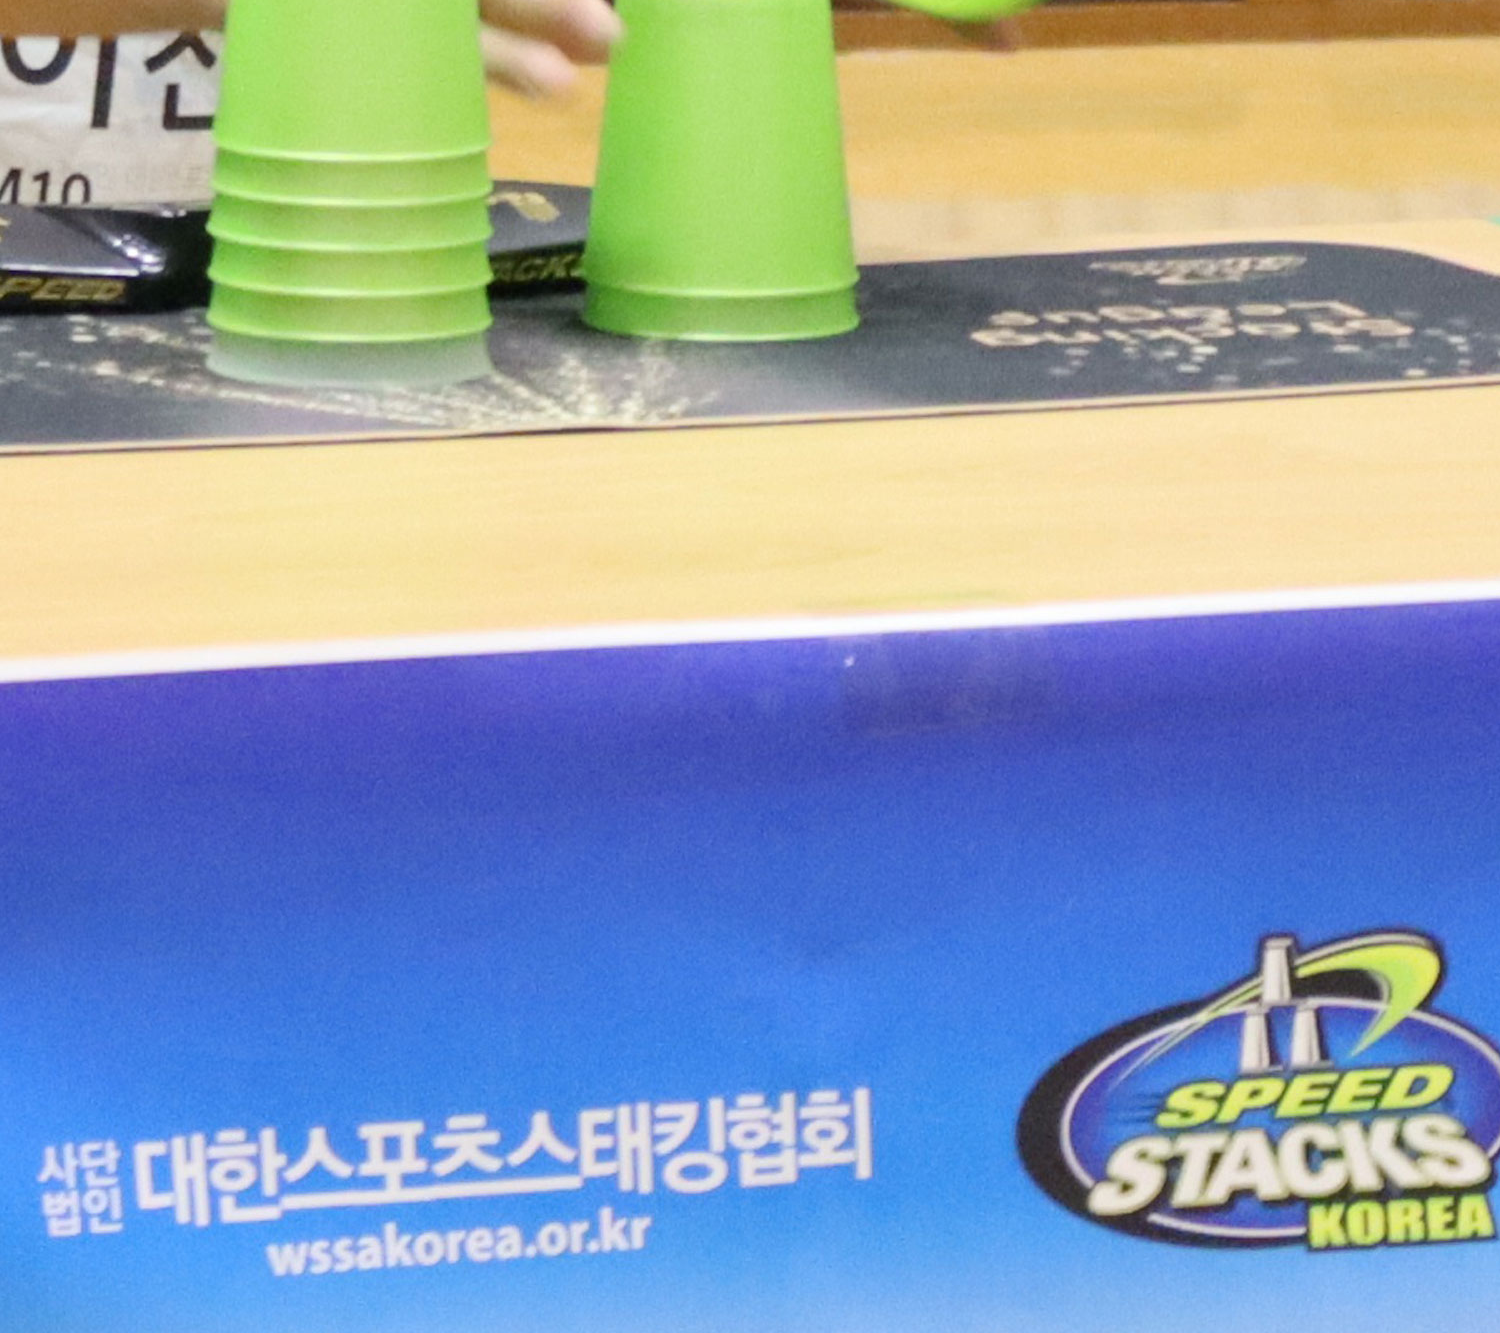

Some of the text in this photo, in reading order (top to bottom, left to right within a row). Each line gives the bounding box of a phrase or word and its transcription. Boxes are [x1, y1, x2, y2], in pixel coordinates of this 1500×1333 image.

[1154, 1064, 1455, 1129] SPEED
[36, 1140, 121, 1190] 사단
[133, 1087, 874, 1227] 대한스포츠스태킹협회
[1088, 1112, 1494, 1217] STACKS
[40, 1186, 124, 1239] 법인
[266, 1206, 651, 1278] wssakorea.or.kr
[1307, 1194, 1495, 1249] KOREA
